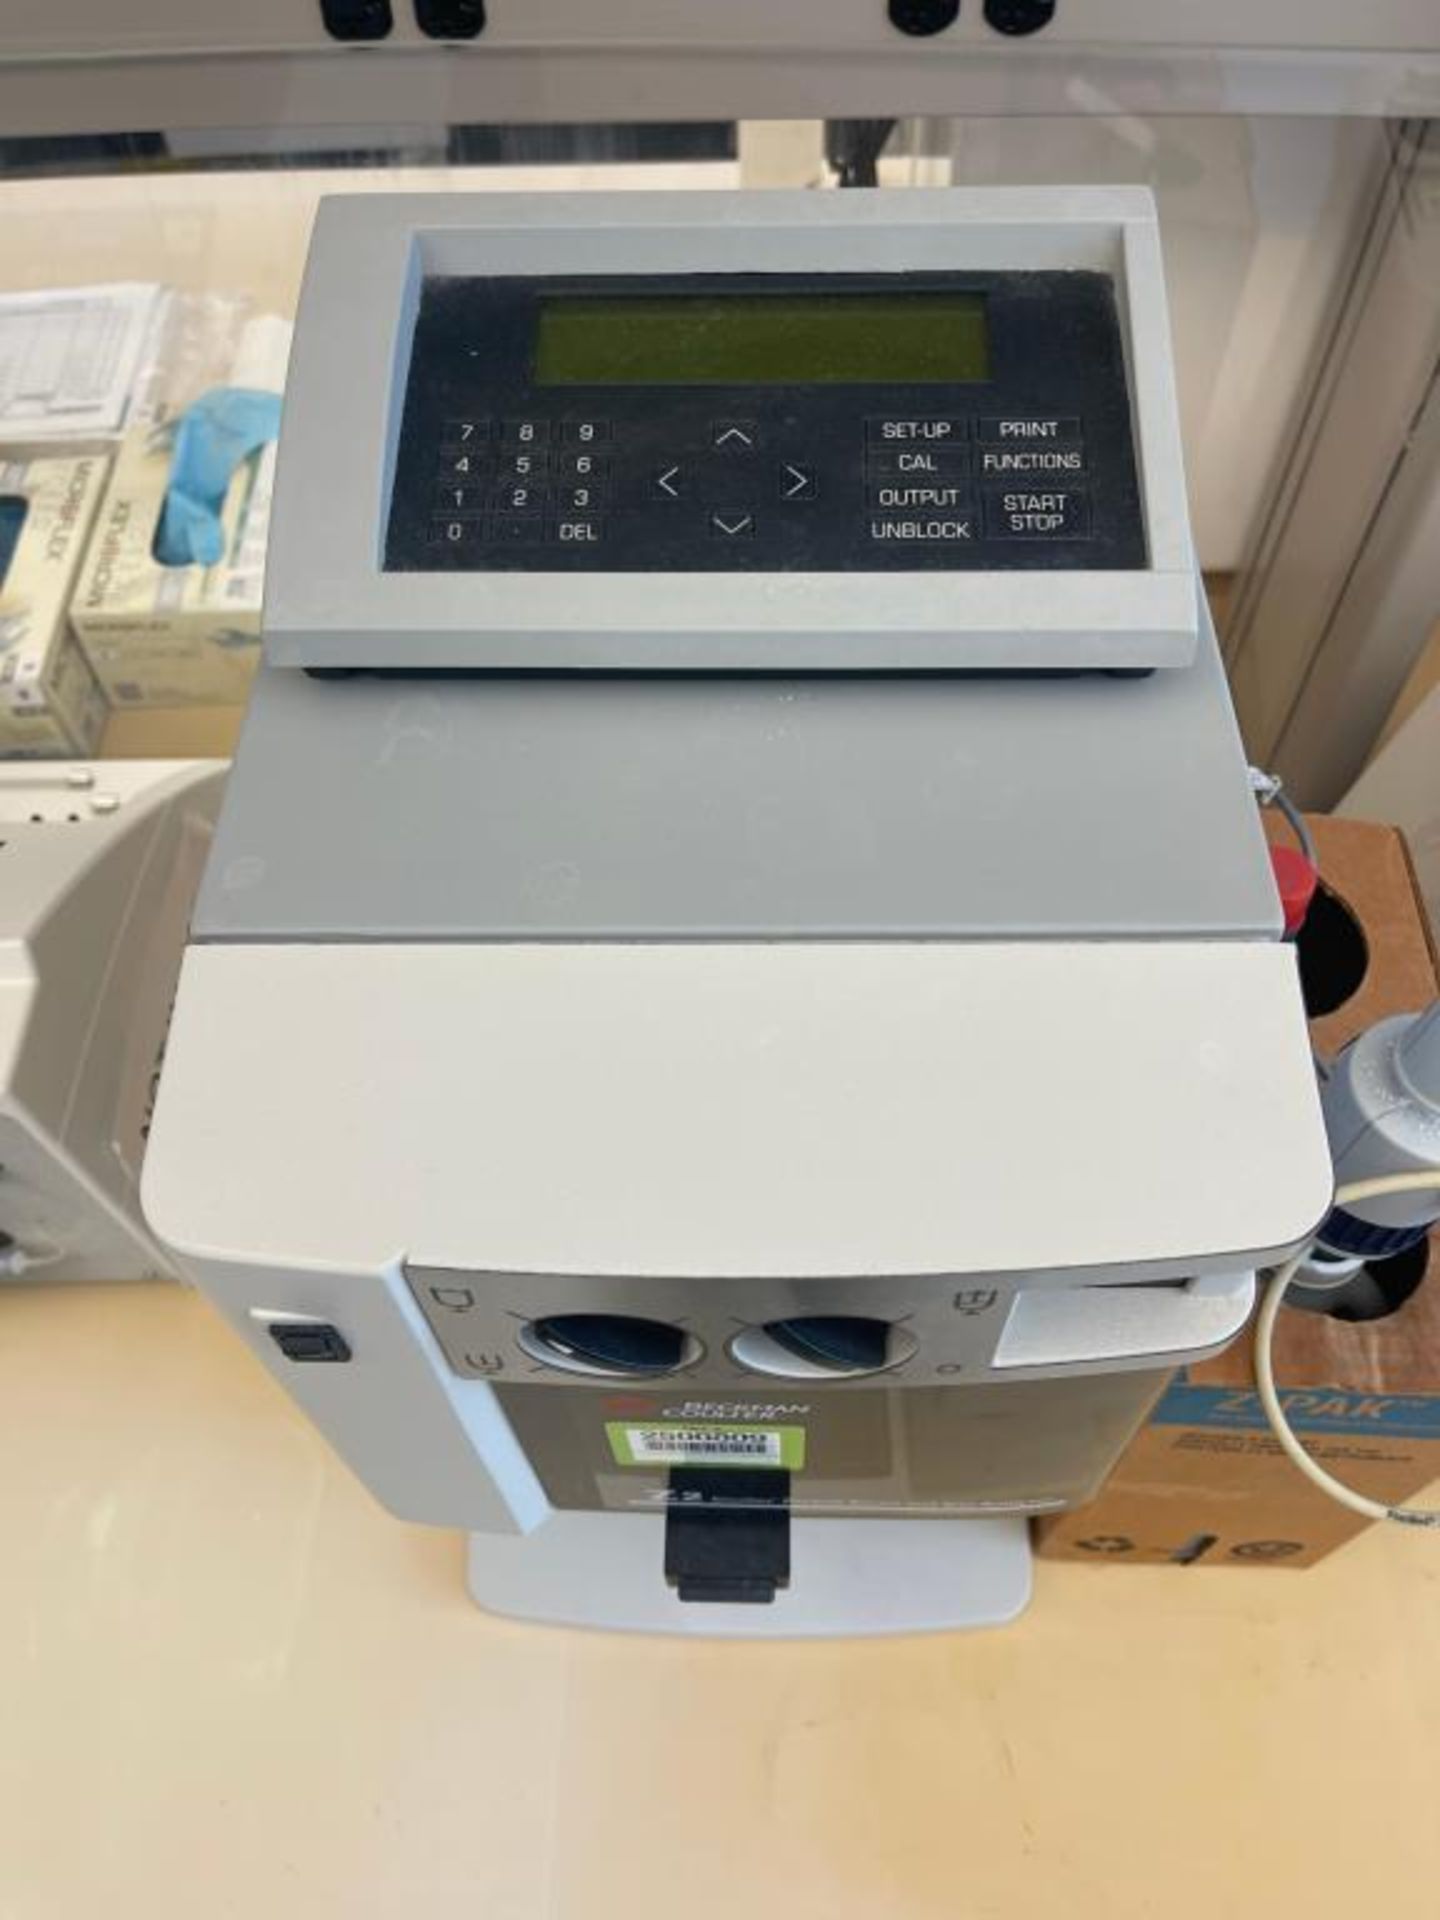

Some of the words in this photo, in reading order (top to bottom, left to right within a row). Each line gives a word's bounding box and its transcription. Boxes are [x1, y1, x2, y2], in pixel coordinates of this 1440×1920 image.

[462, 425, 473, 440] 7
[520, 425, 533, 440] 8
[580, 425, 593, 440] 9
[883, 422, 950, 438] SET-UP
[1000, 422, 1057, 436] PRINT
[456, 458, 468, 471] 4
[517, 457, 529, 473] 5
[577, 457, 590, 472] 6
[899, 454, 936, 470] CAL
[985, 454, 1080, 468] FUNCTIONS
[455, 490, 462, 505] 1
[513, 490, 526, 505] 2
[575, 490, 588, 505] 3
[880, 489, 958, 505] OUTPUT
[1004, 495, 1066, 510] START
[872, 522, 969, 538] UNBLOCK
[1011, 515, 1063, 530] STOP
[560, 524, 596, 540] DEL
[1212, 1391, 1395, 1419] ZPAK
